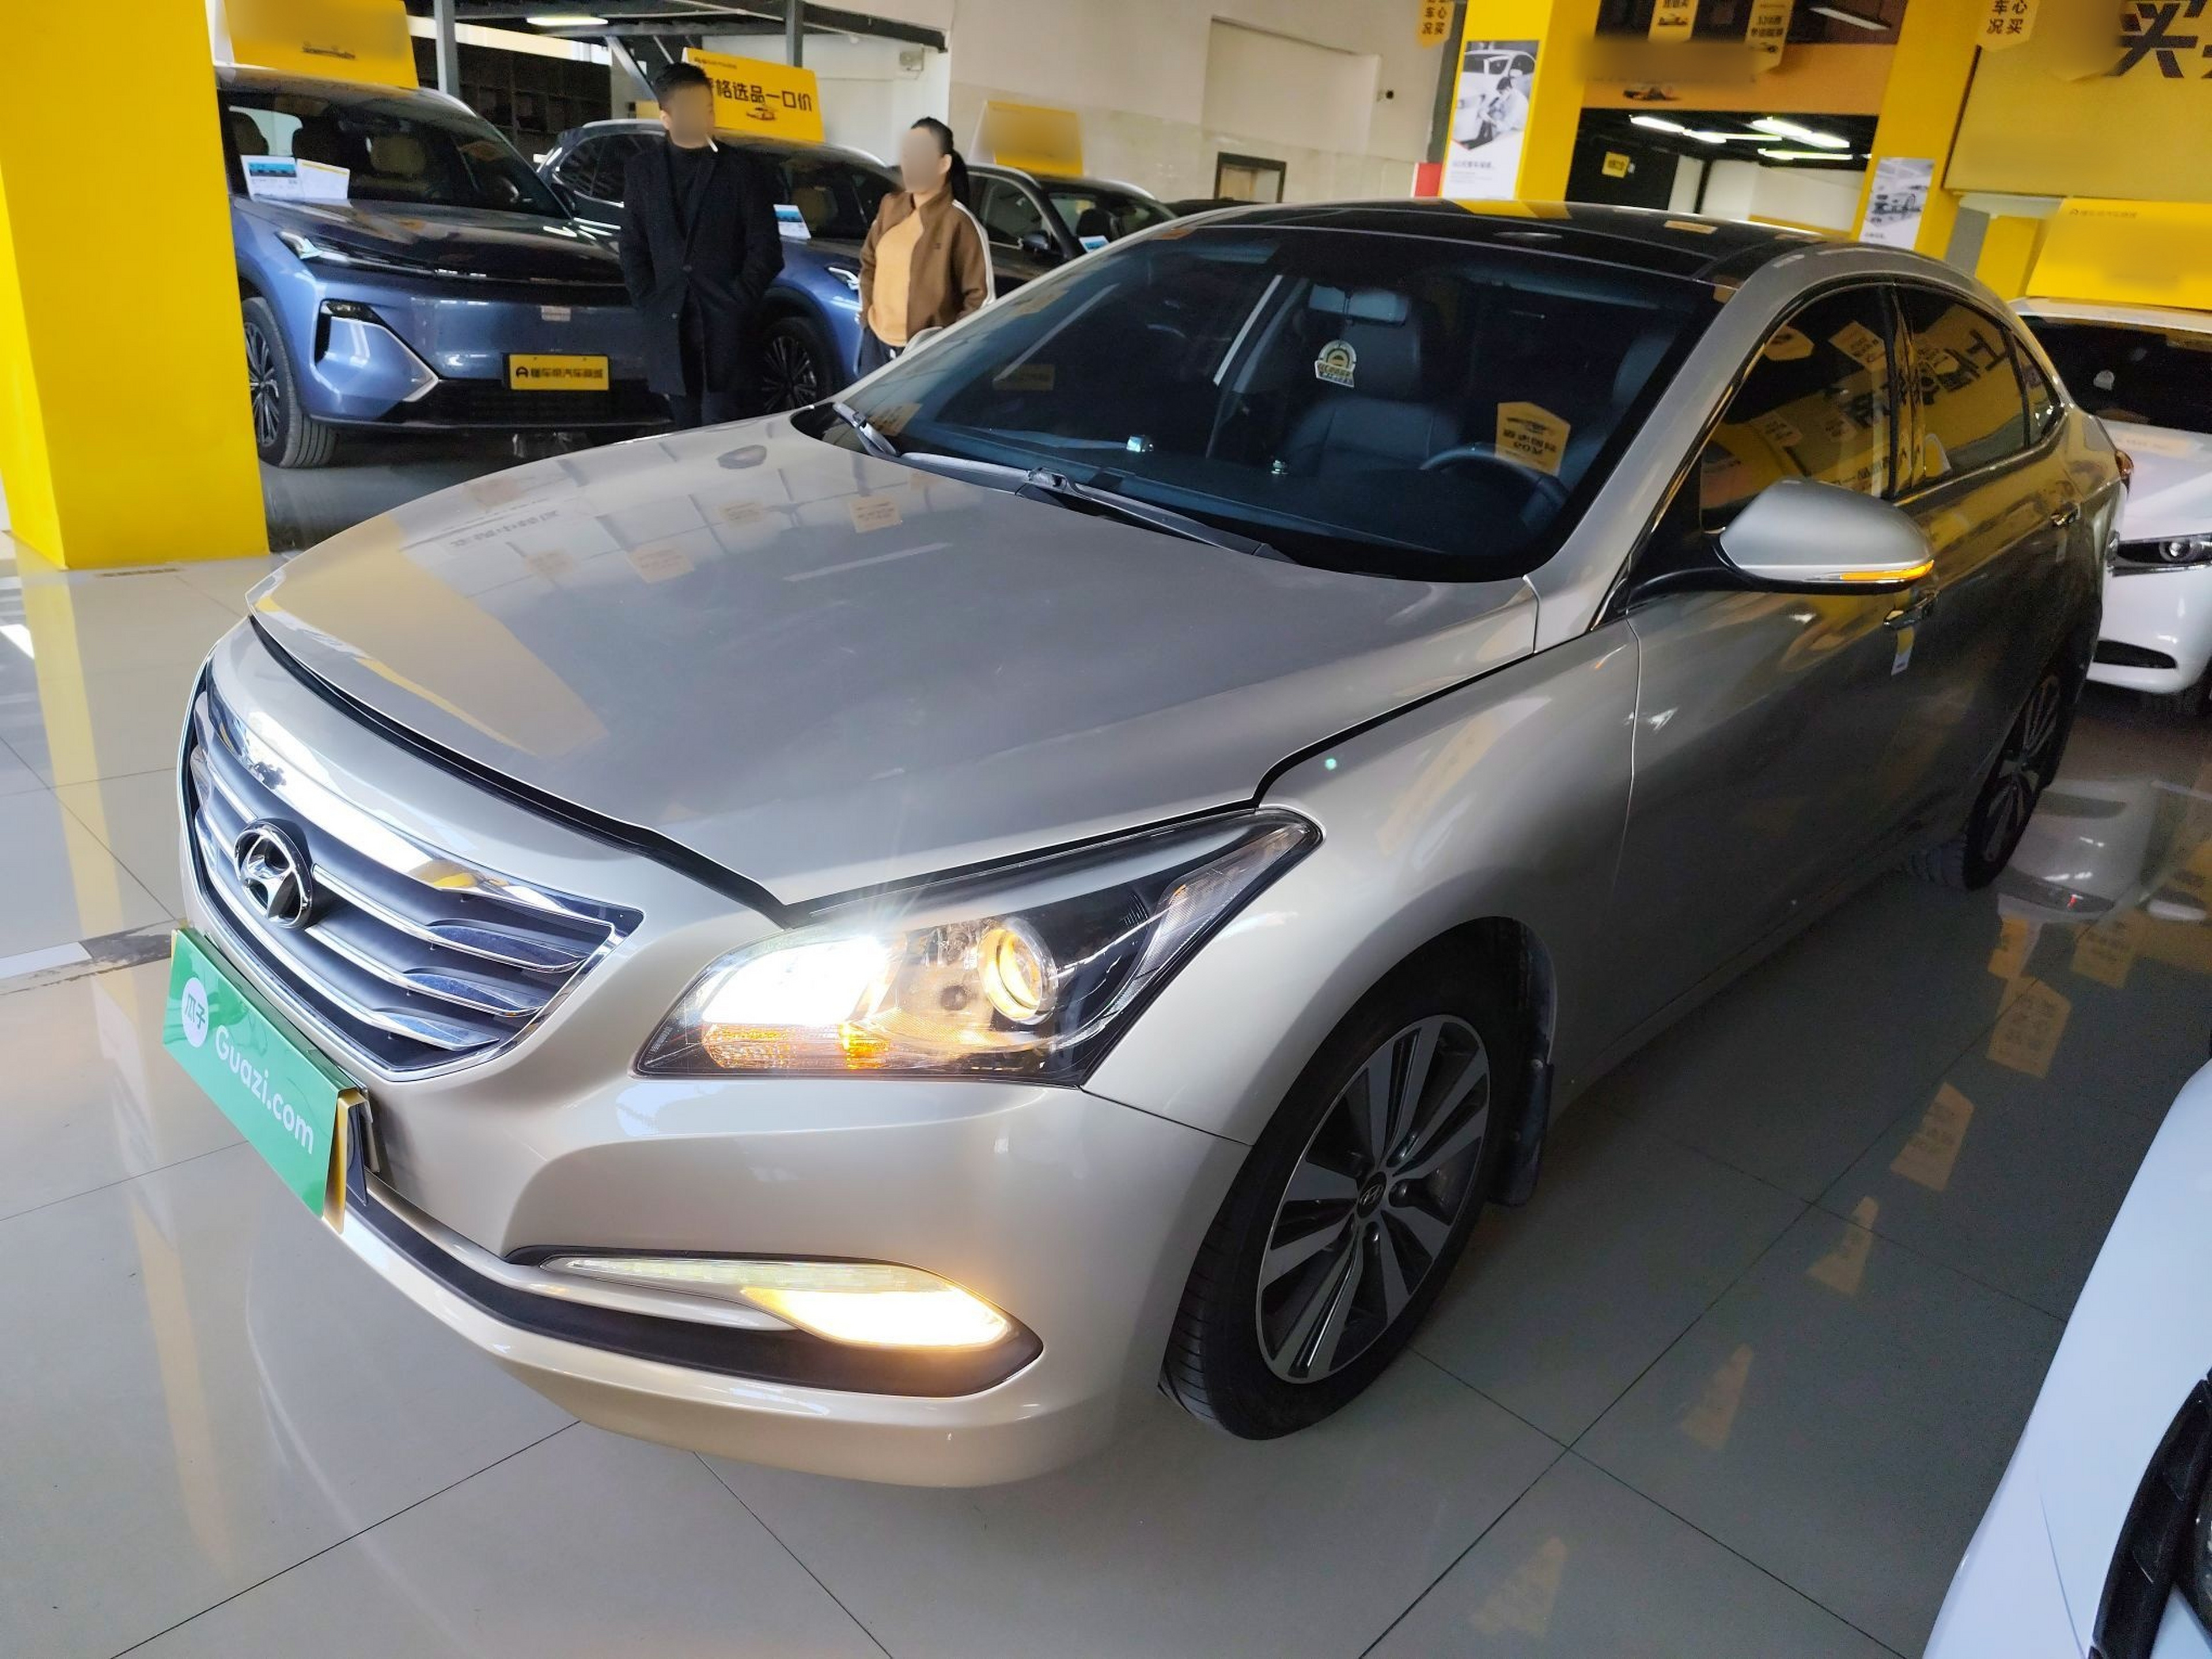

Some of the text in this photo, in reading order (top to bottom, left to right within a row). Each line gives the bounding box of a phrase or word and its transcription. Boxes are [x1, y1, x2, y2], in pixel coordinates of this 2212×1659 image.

[707, 78, 812, 111] 格选品一口价
[185, 994, 206, 1028] 瓜子
[215, 1024, 314, 1154] Guazi.com
